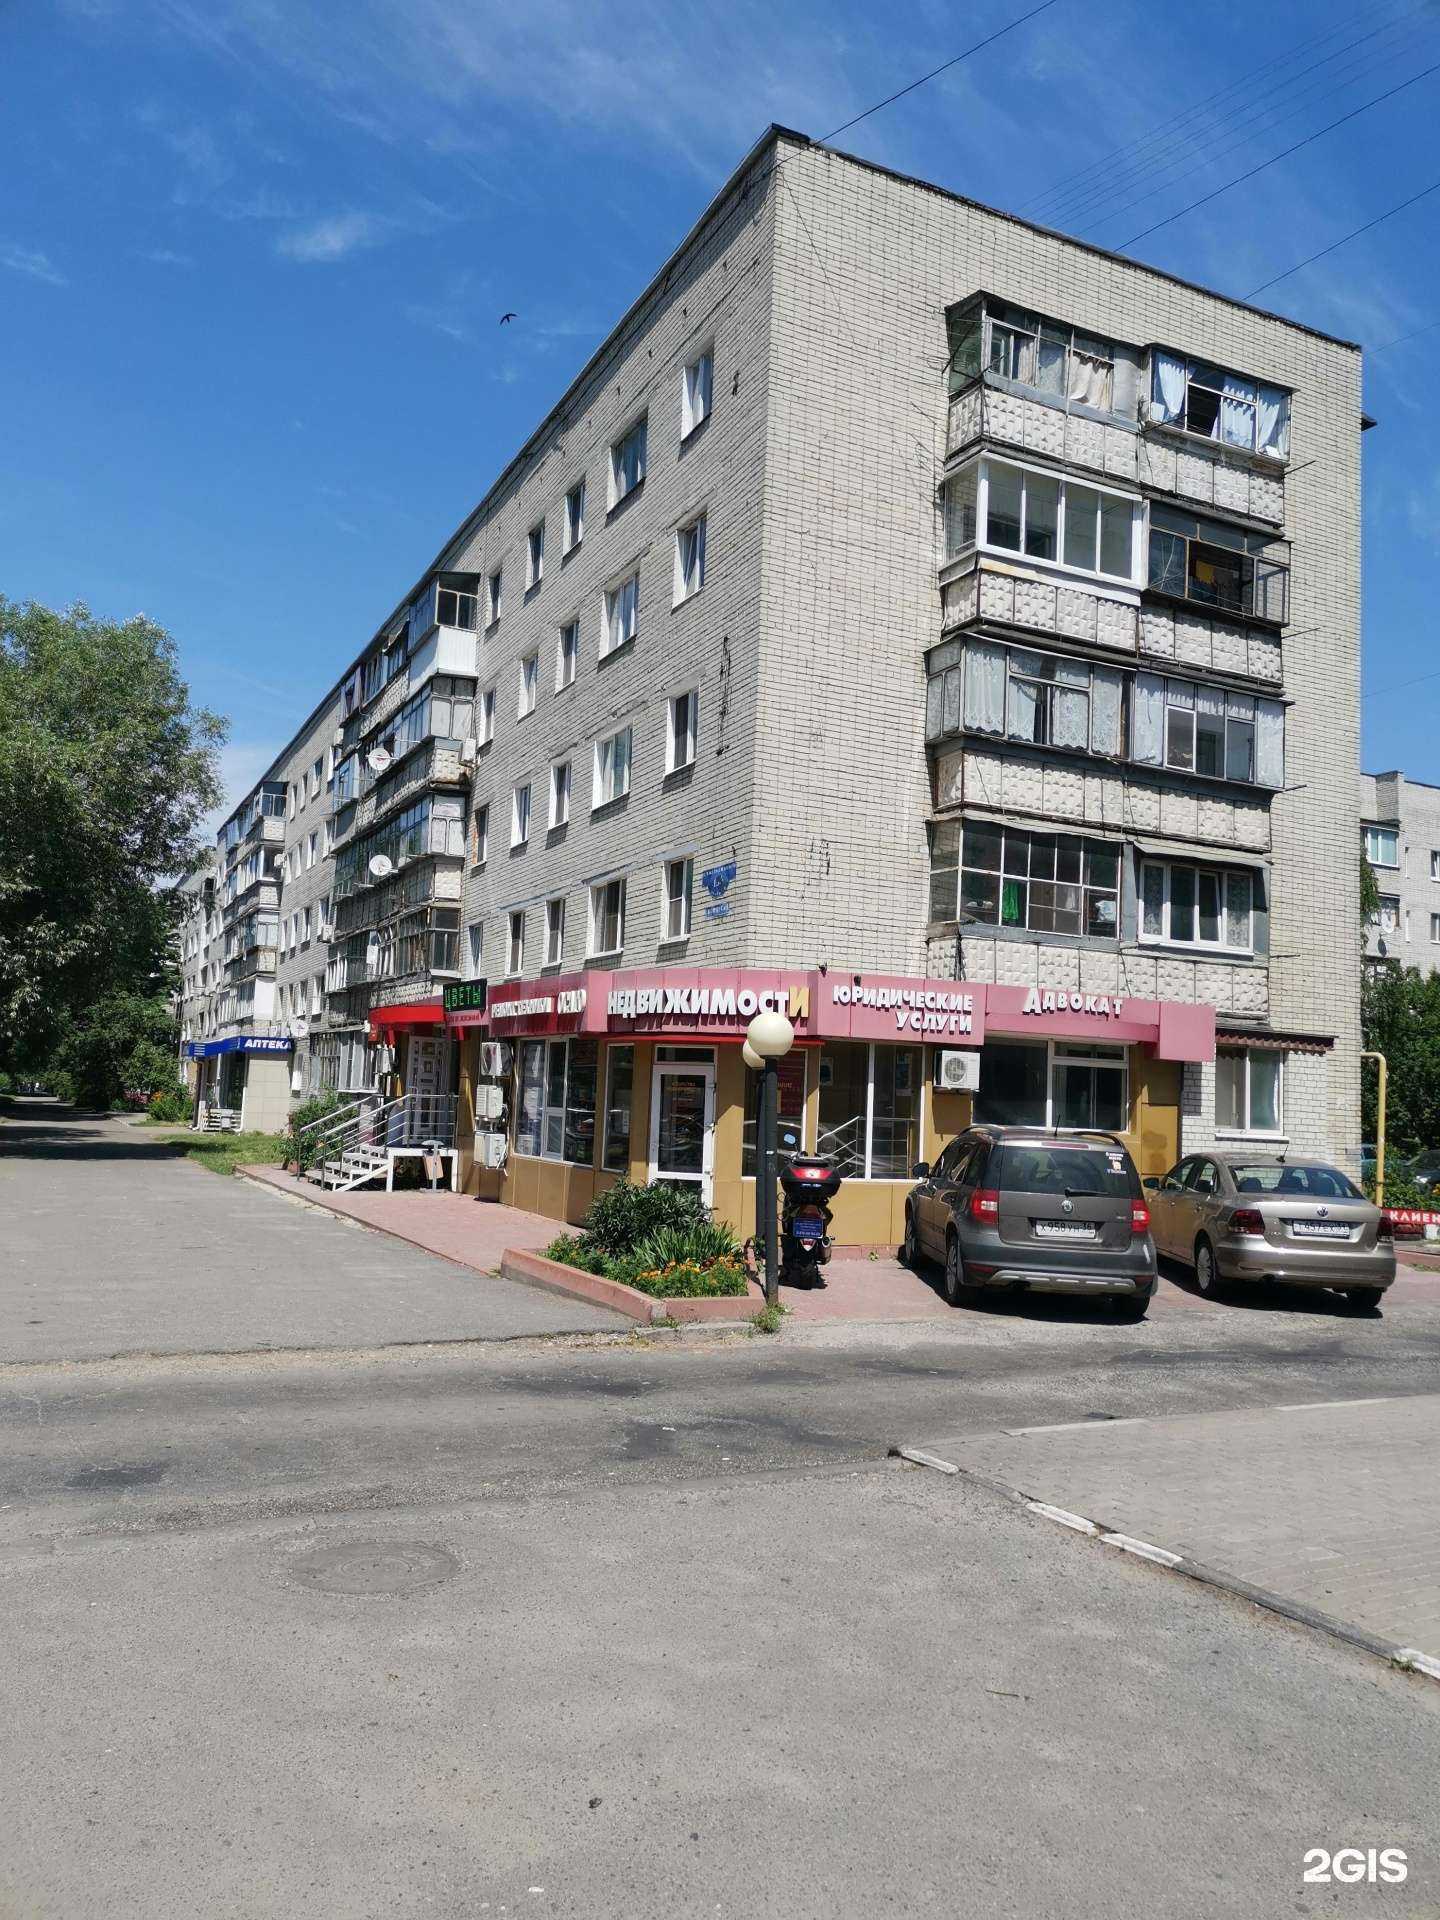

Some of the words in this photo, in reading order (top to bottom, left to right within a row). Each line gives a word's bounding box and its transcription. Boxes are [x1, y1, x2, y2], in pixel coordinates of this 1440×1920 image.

[445, 985, 481, 1011] ЦВЕТЫ
[607, 986, 810, 1018] НЕДВИЖИМОСТИ
[833, 985, 973, 1012] ЮРИДИЧЕСКИЕ
[896, 1011, 972, 1033] УСЛУГИ
[244, 1038, 292, 1049] АПТЕКА
